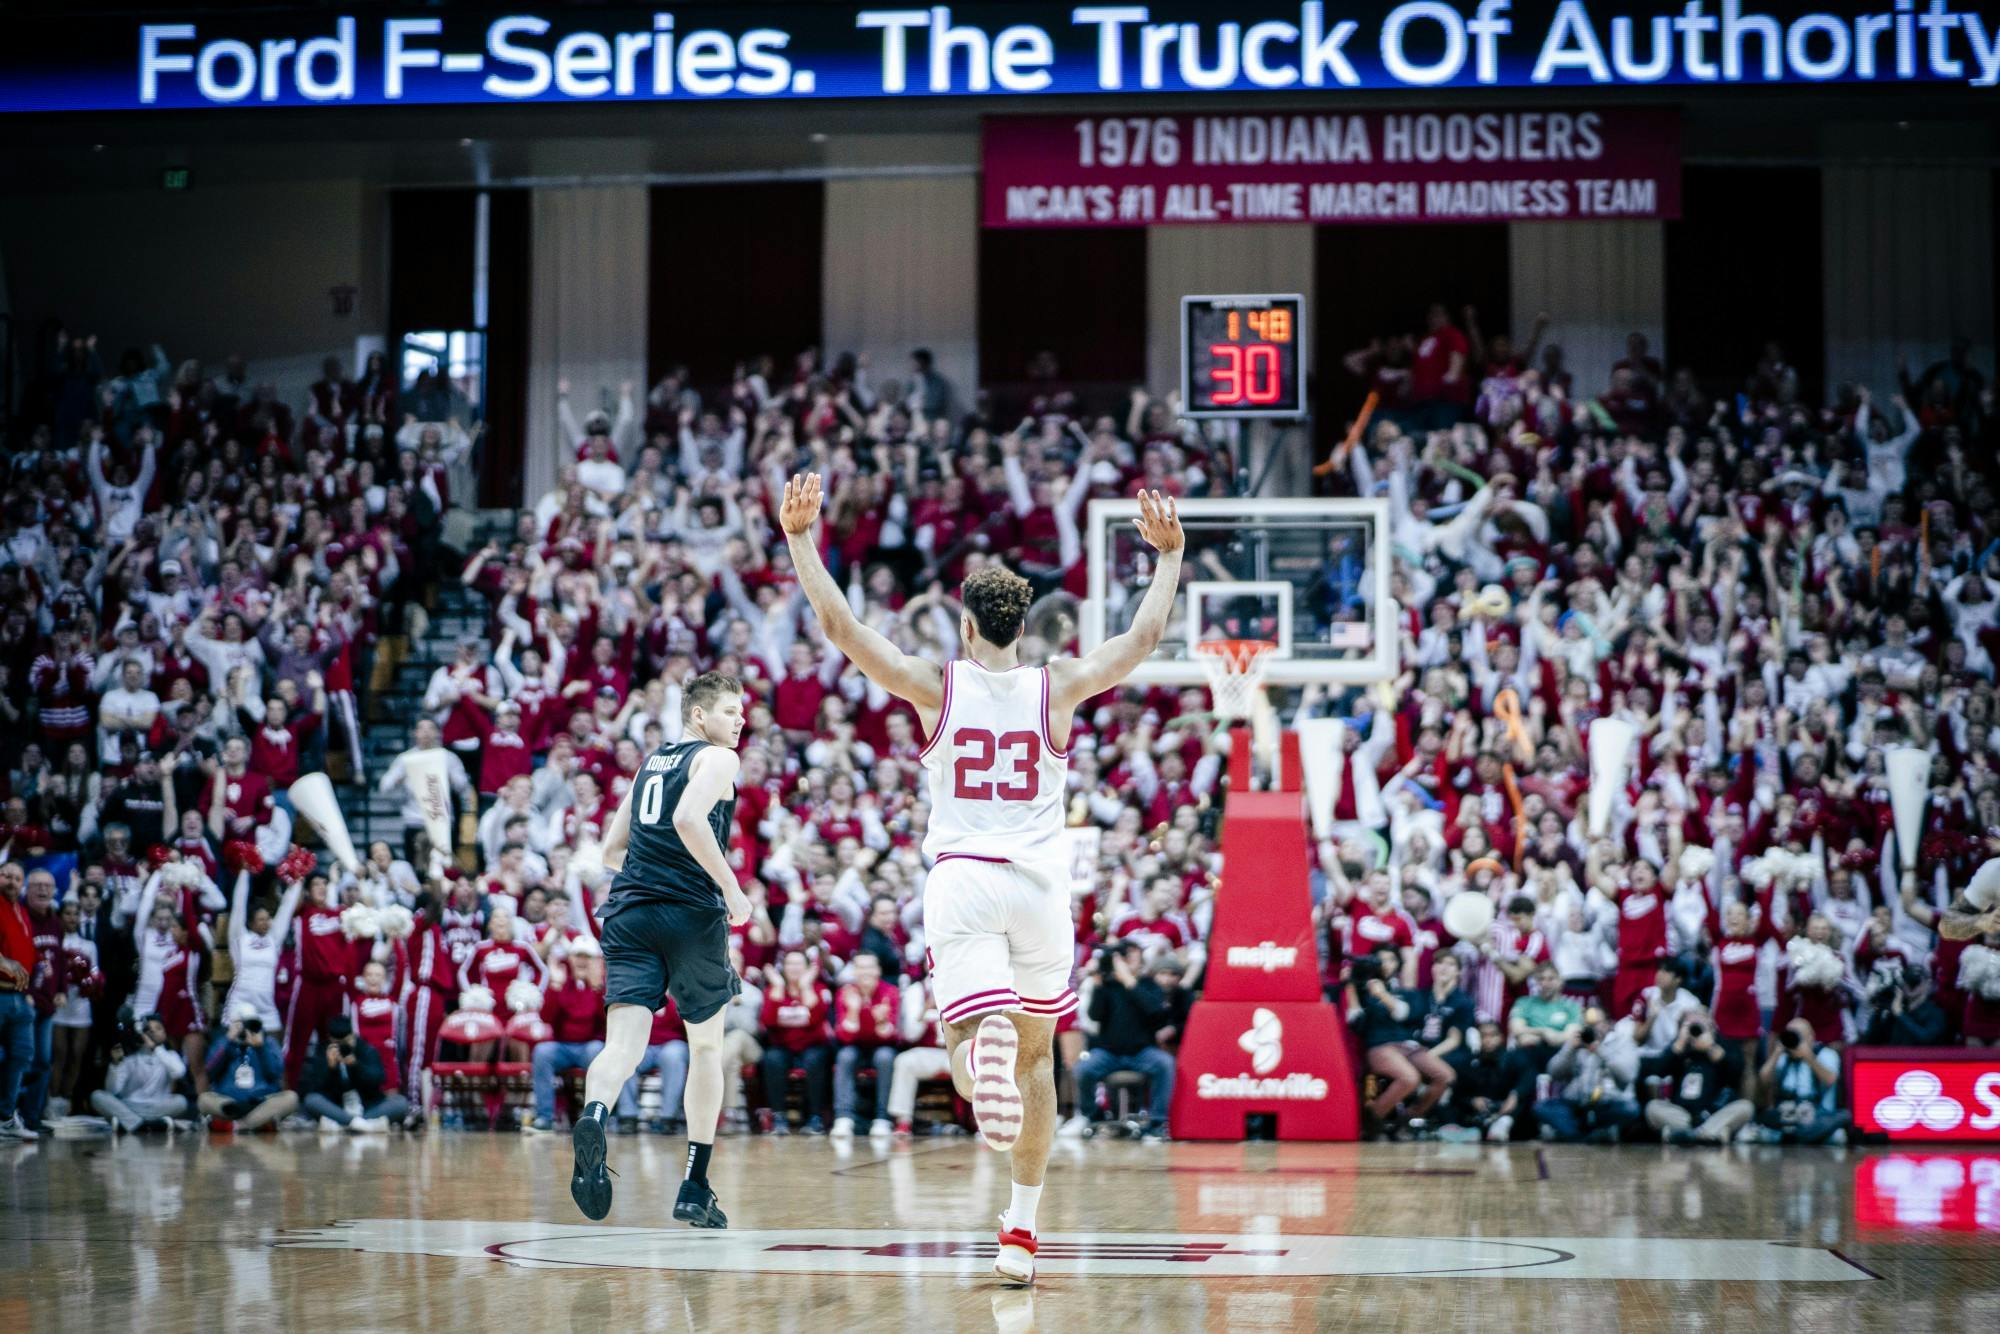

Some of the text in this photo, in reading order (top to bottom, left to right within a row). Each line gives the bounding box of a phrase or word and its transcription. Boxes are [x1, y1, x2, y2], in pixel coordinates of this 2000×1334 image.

[139, 0, 2000, 104] Ford F-Series. The Truck Of Authority
[1076, 112, 1603, 167] 1976 INDIANA HOOSIERS
[1006, 178, 1656, 222] NCAA'S #1 ALL-TIME MARCH MADNESS TEAM
[1209, 343, 1282, 405] 30
[954, 727, 1041, 802] 23
[638, 774, 664, 825] 0
